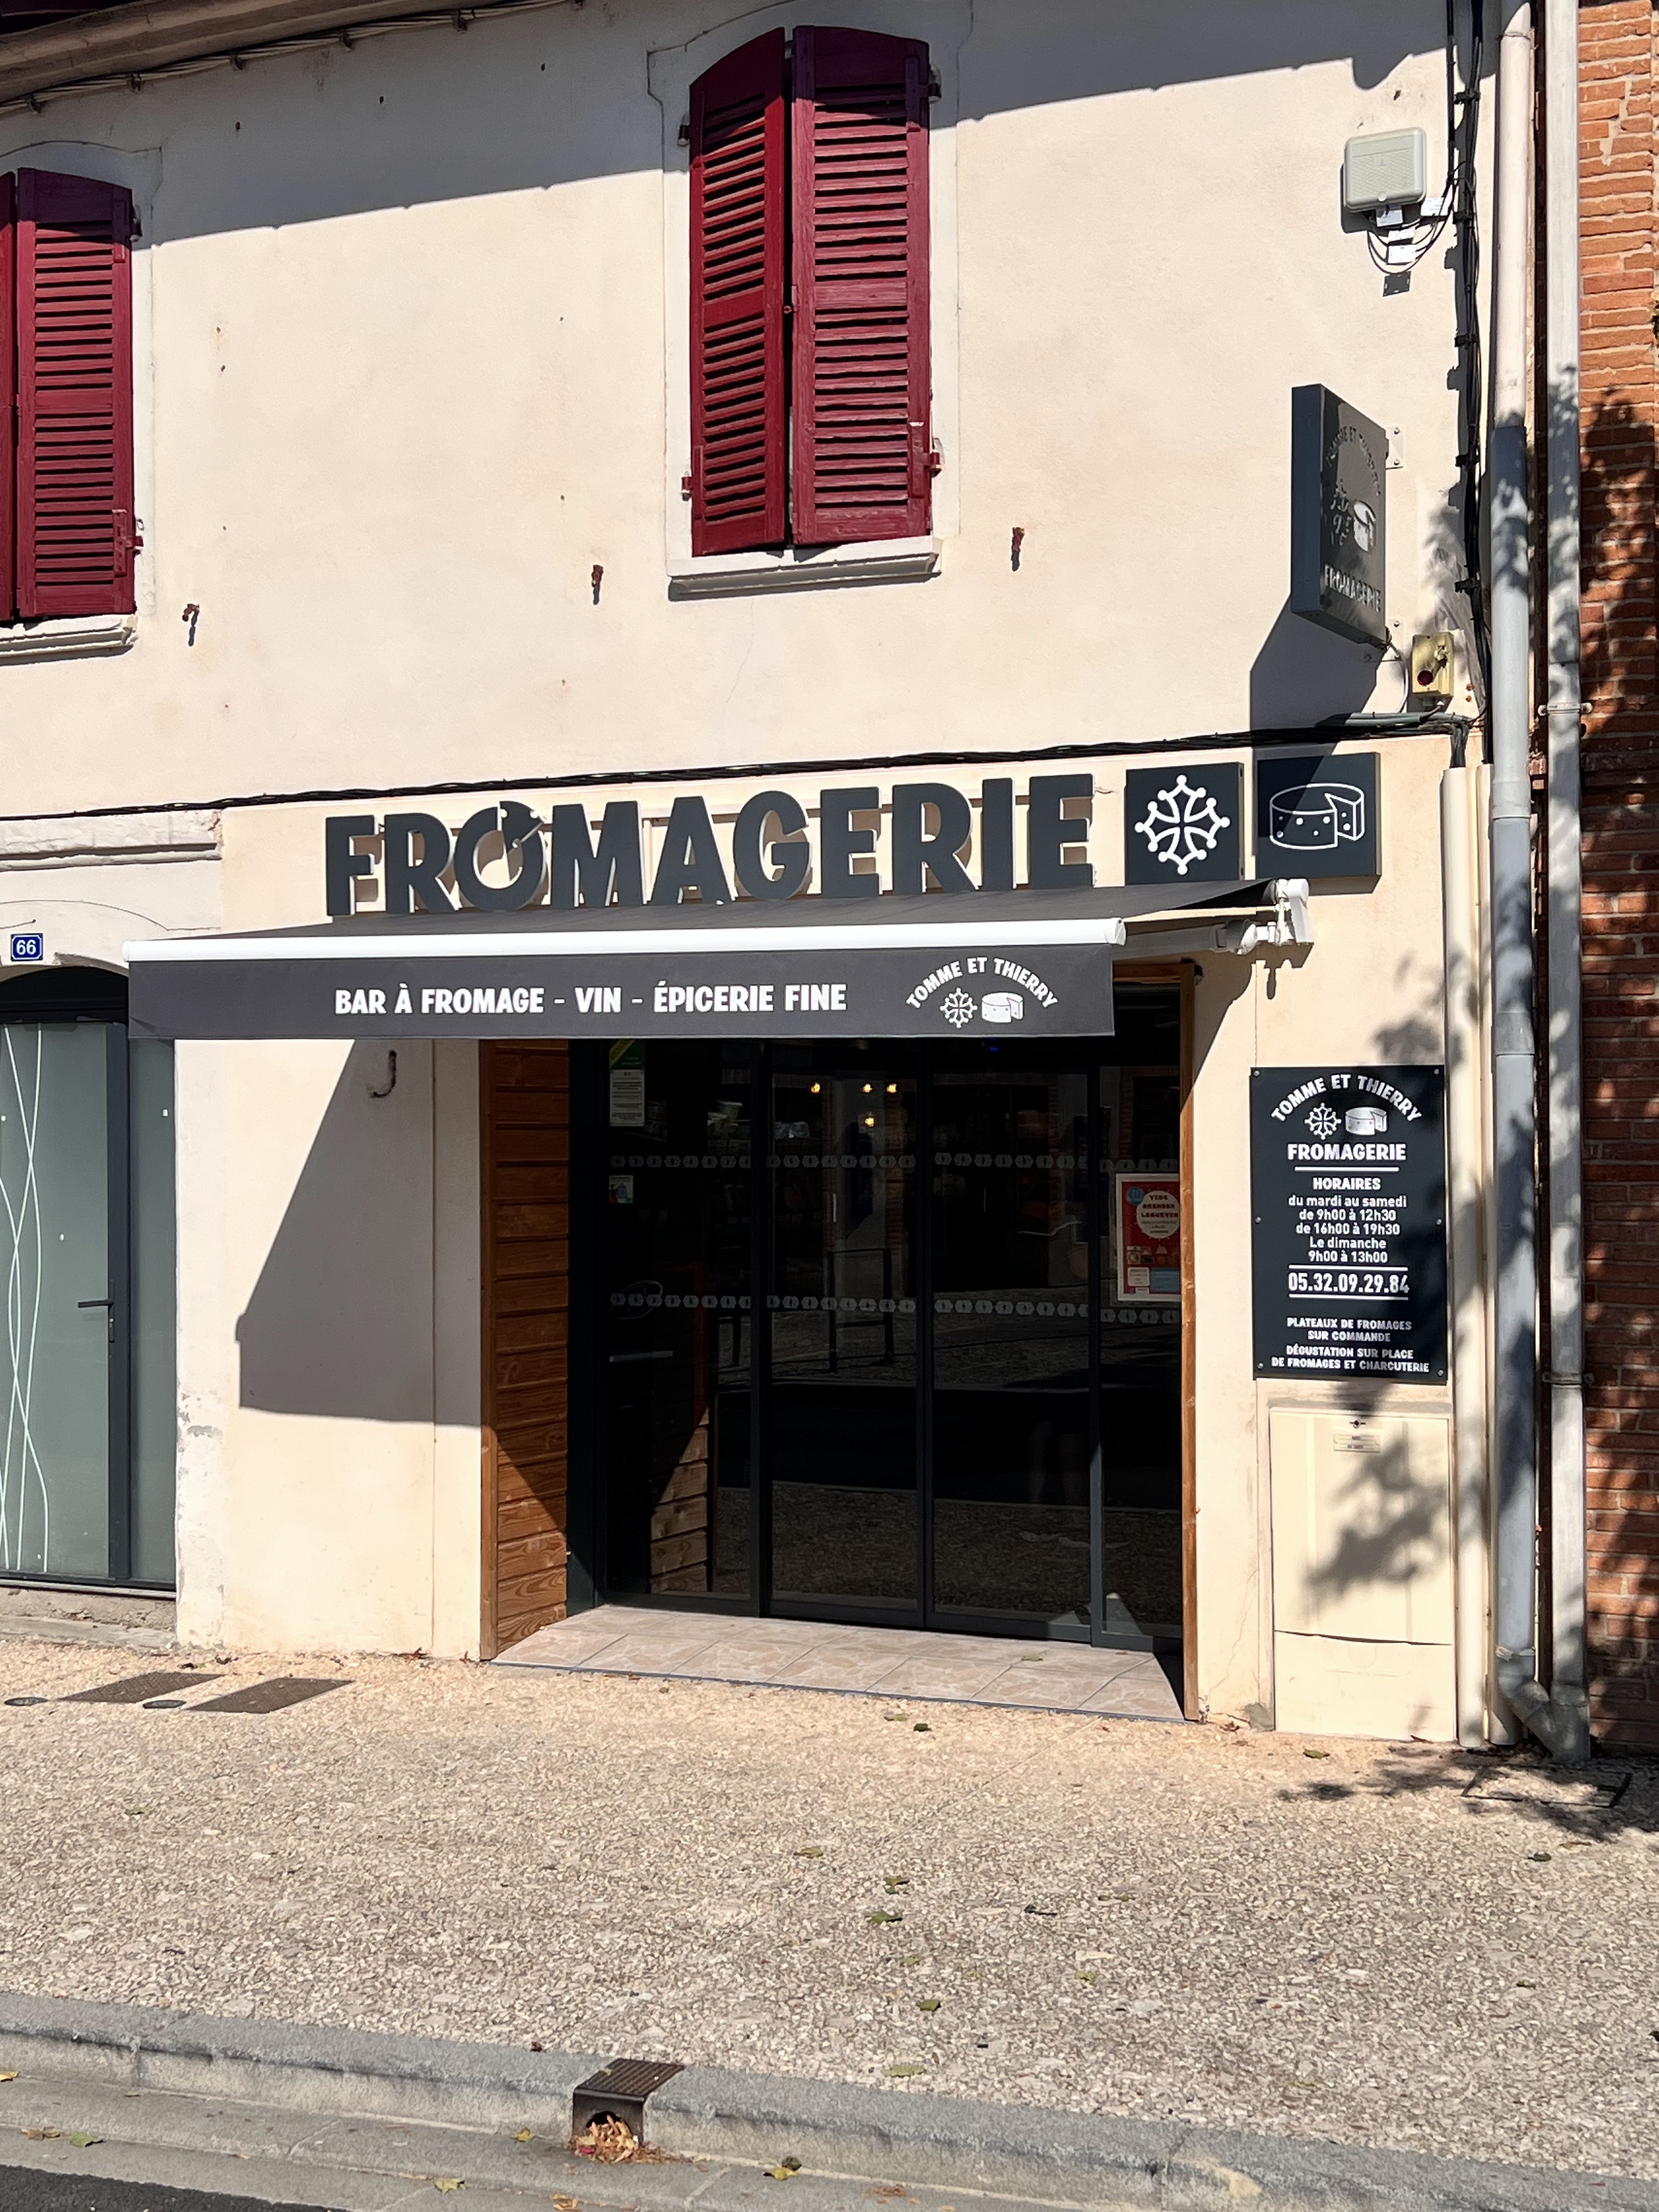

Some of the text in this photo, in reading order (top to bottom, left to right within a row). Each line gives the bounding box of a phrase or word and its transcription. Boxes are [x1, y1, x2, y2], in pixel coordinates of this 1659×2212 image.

[1323, 563, 1381, 614] FROMAGERIE
[326, 774, 1093, 916] FROMAGERIE
[16, 939, 36, 955] 66
[906, 957, 1058, 1008] TOMME ET THIERRY
[336, 990, 386, 1014] BAR
[394, 984, 412, 1013] À
[422, 988, 544, 1013] FROMAGE
[575, 988, 621, 1012] VIN
[654, 981, 774, 1012] ÉPICERIE
[786, 984, 846, 1011] FINE
[1271, 1074, 1422, 1121] TOMME ET THIERRY
[1288, 1144, 1406, 1160] FROMAGERIE
[1313, 1178, 1380, 1190] HORAIRES
[1289, 1195, 1406, 1207] du mardi au samedi
[1299, 1209, 1396, 1221] de 9h00 à 12h30
[1296, 1222, 1400, 1235] de 16h00 à 19h30
[1310, 1236, 1386, 1249] Le dimanche
[1308, 1250, 1387, 1263] 9h00 à 13h00
[1289, 1273, 1409, 1293] 05.32.09.29.84
[1287, 1318, 1412, 1330] PLATEAUX DE FROMAGES
[1308, 1330, 1390, 1341] SUR COMMANDE
[1286, 1344, 1413, 1359] DÉGUSTATION SUR PLACE
[1272, 1357, 1429, 1372] DE FROMAGES ET CHARCUTERIE
